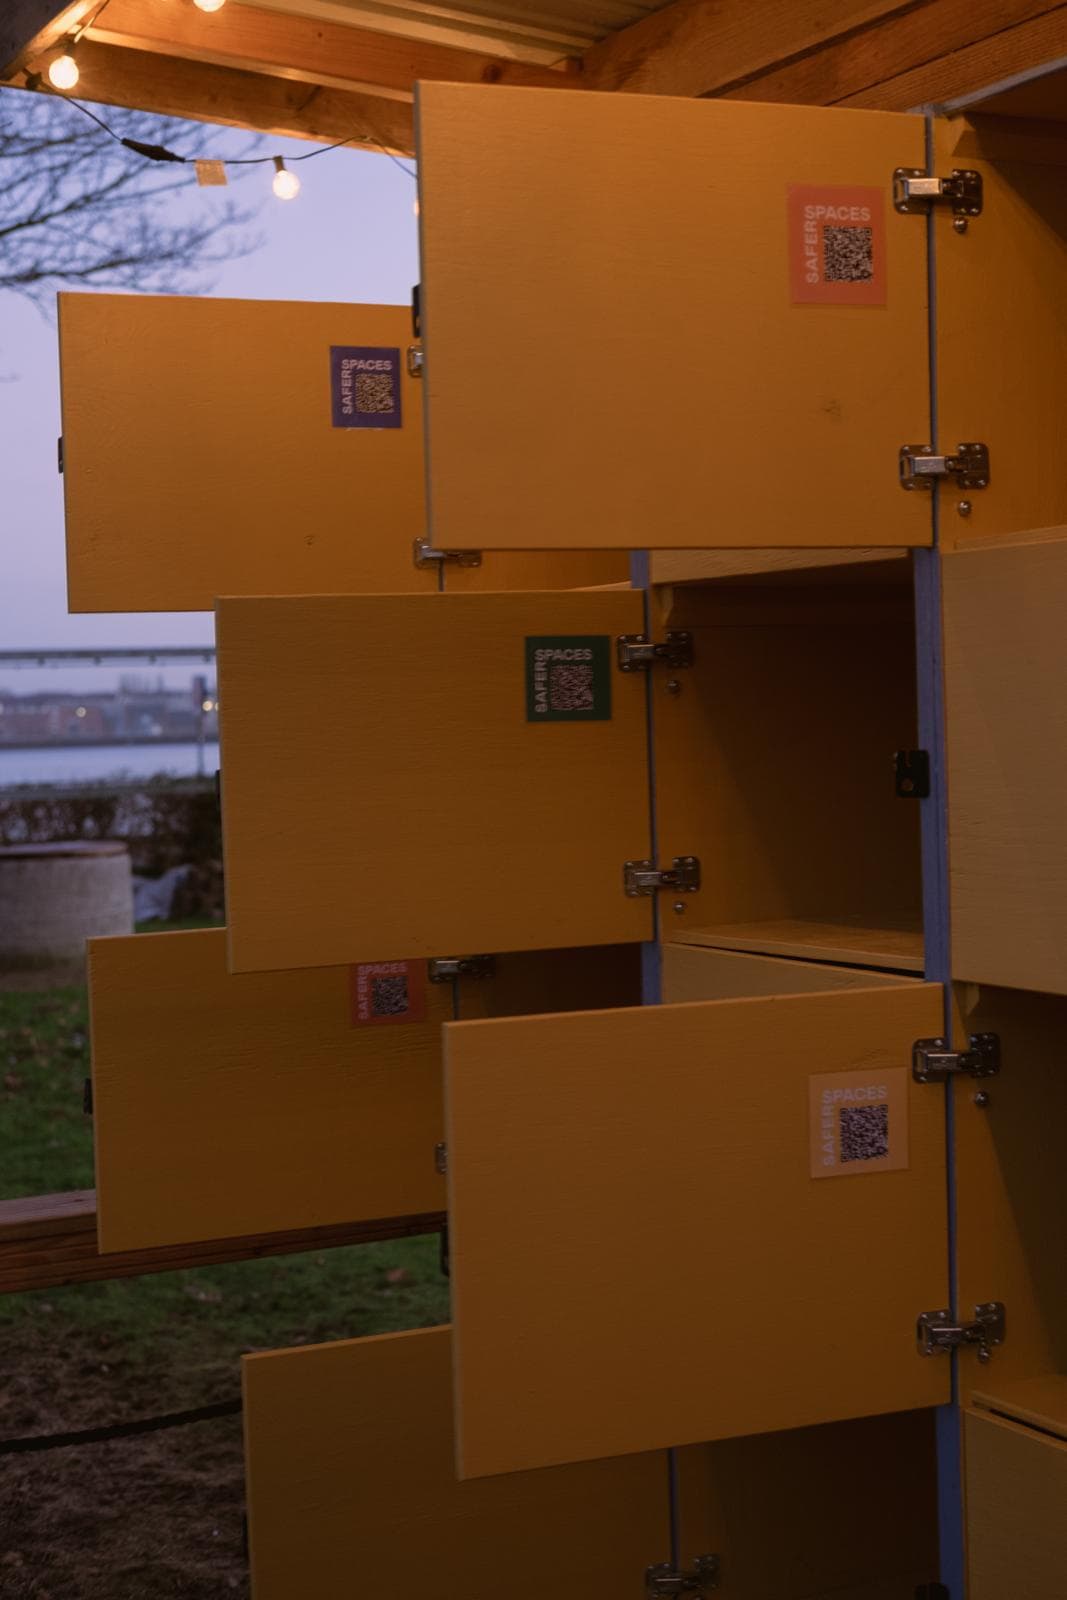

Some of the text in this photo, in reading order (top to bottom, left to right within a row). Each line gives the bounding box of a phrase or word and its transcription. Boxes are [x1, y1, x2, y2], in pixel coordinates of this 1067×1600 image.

[804, 205, 871, 221] SPACES
[804, 220, 819, 283] SAFER
[341, 359, 393, 371] SPACES
[341, 370, 352, 415] SAFER
[535, 648, 593, 661] SPACES
[534, 661, 548, 713] SAFER
[358, 962, 407, 975] SPACES
[358, 976, 368, 1019] SAFER
[822, 1085, 888, 1103] SPACES
[822, 1103, 835, 1167] SAFER
